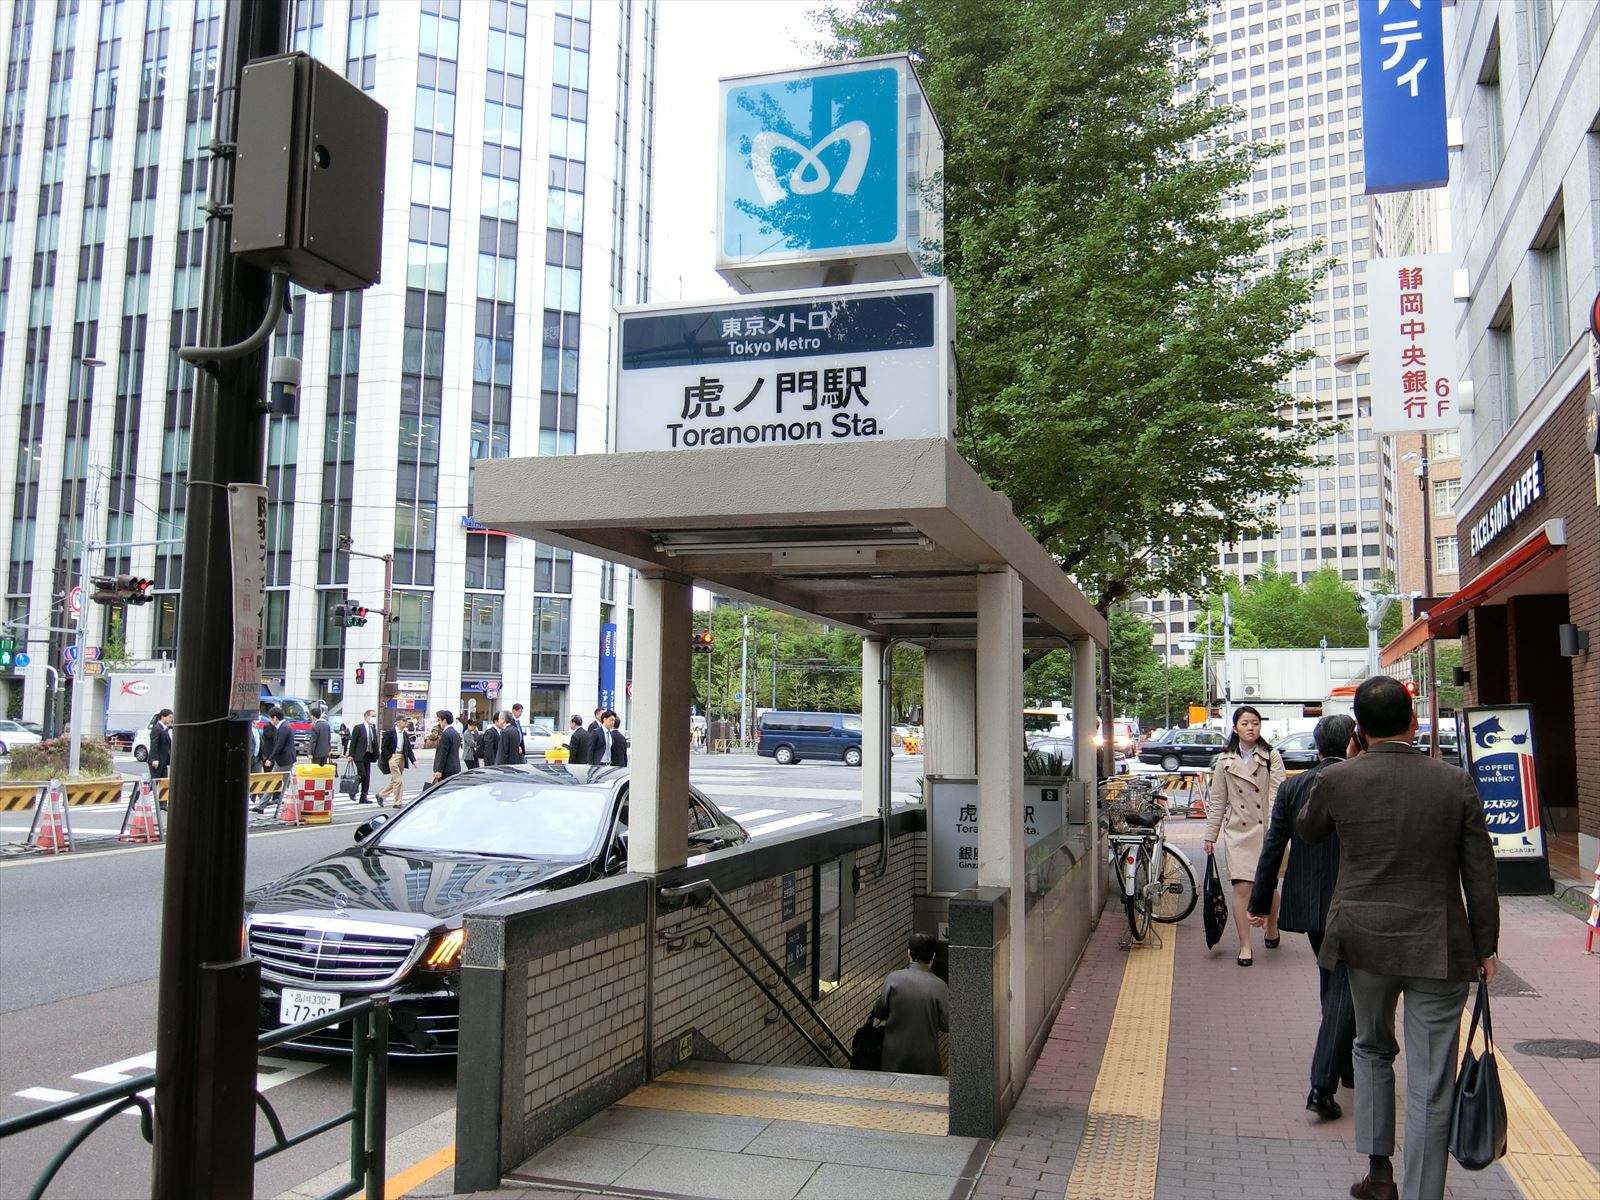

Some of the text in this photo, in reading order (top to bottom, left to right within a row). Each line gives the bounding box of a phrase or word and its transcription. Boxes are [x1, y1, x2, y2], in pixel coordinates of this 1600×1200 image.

[721, 311, 828, 339] 東京メトロ
[1398, 267, 1428, 419] 静岡中央銀行
[728, 337, 821, 356] Tokyo Metro
[681, 366, 870, 420] 虎ノ門駅
[1435, 377, 1450, 416] 6F
[667, 412, 884, 448] Toranomon Sta.
[1471, 494, 1508, 557] EXCELSIOR
[1046, 790, 1053, 800] 8
[1485, 812, 1520, 824] ケルン
